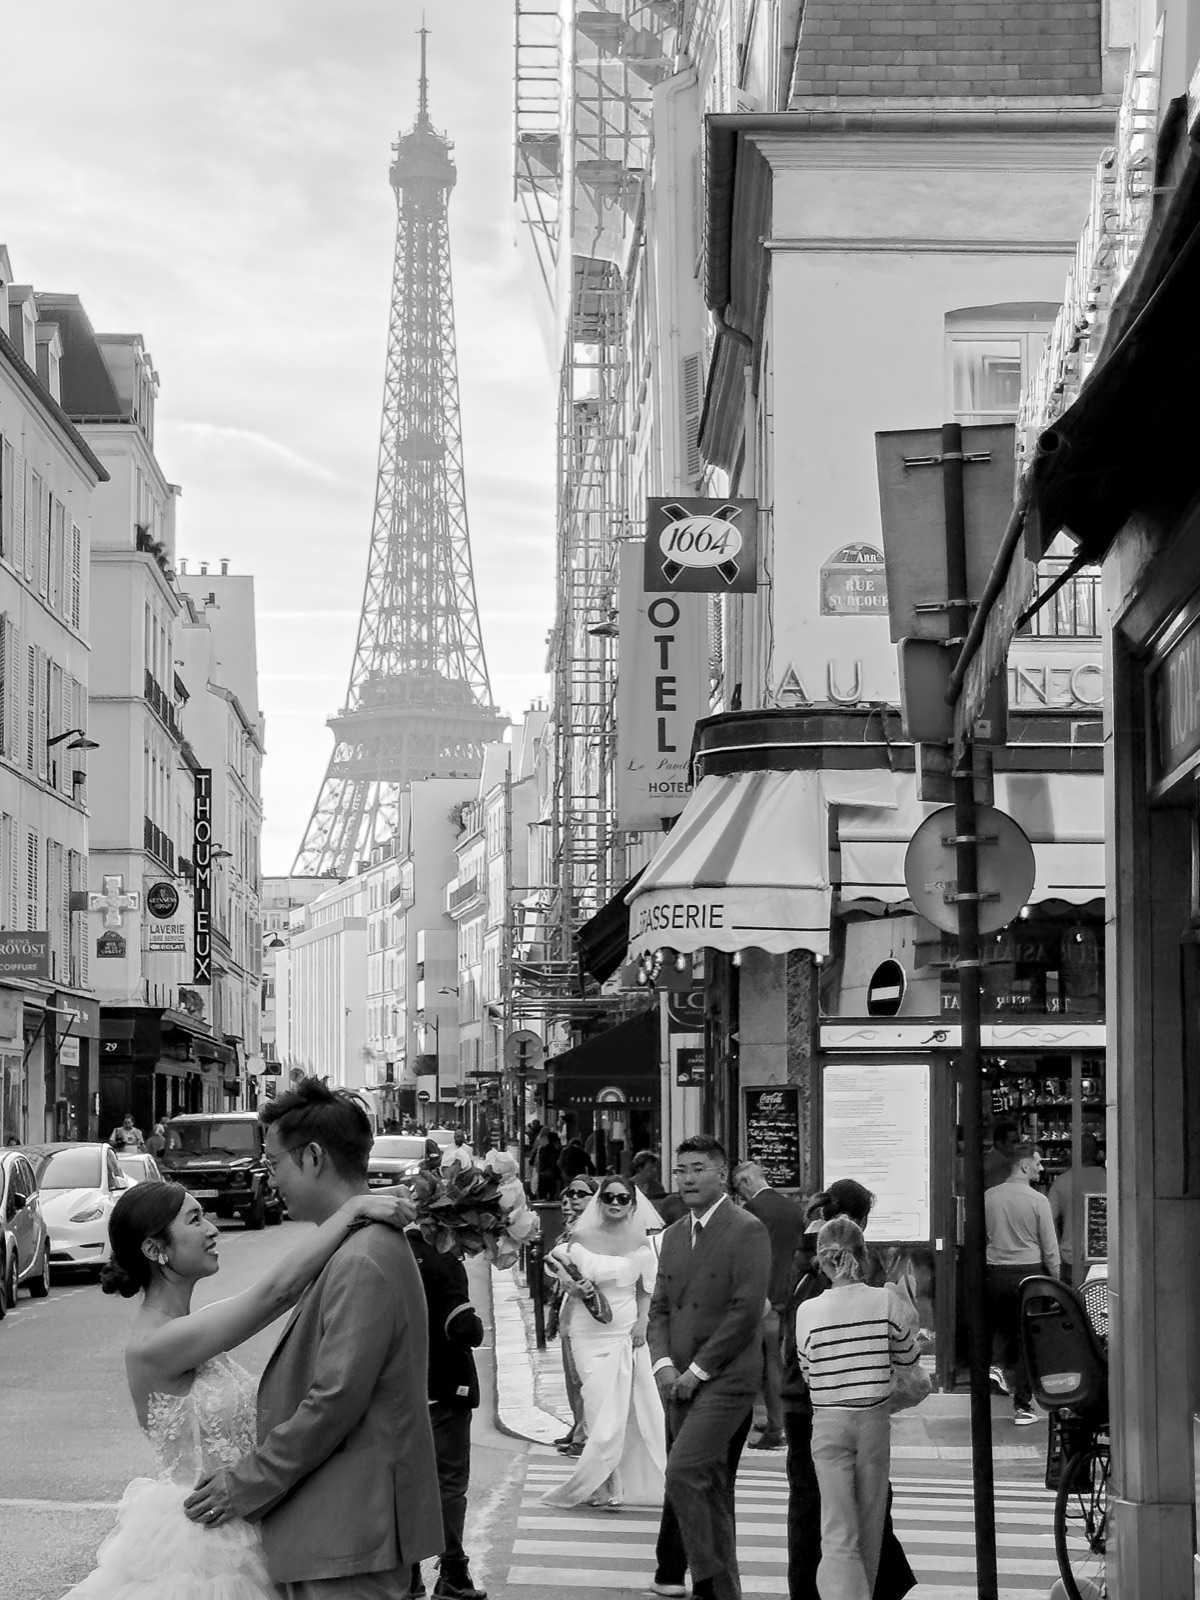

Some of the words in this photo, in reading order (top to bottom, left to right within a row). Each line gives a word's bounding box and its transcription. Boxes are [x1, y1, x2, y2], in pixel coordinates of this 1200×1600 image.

[667, 523, 735, 555] 1664
[845, 580, 875, 592] RUE
[776, 661, 863, 706] AU
[195, 774, 211, 979] THOUMIEUX
[149, 924, 186, 935] LAVERIE
